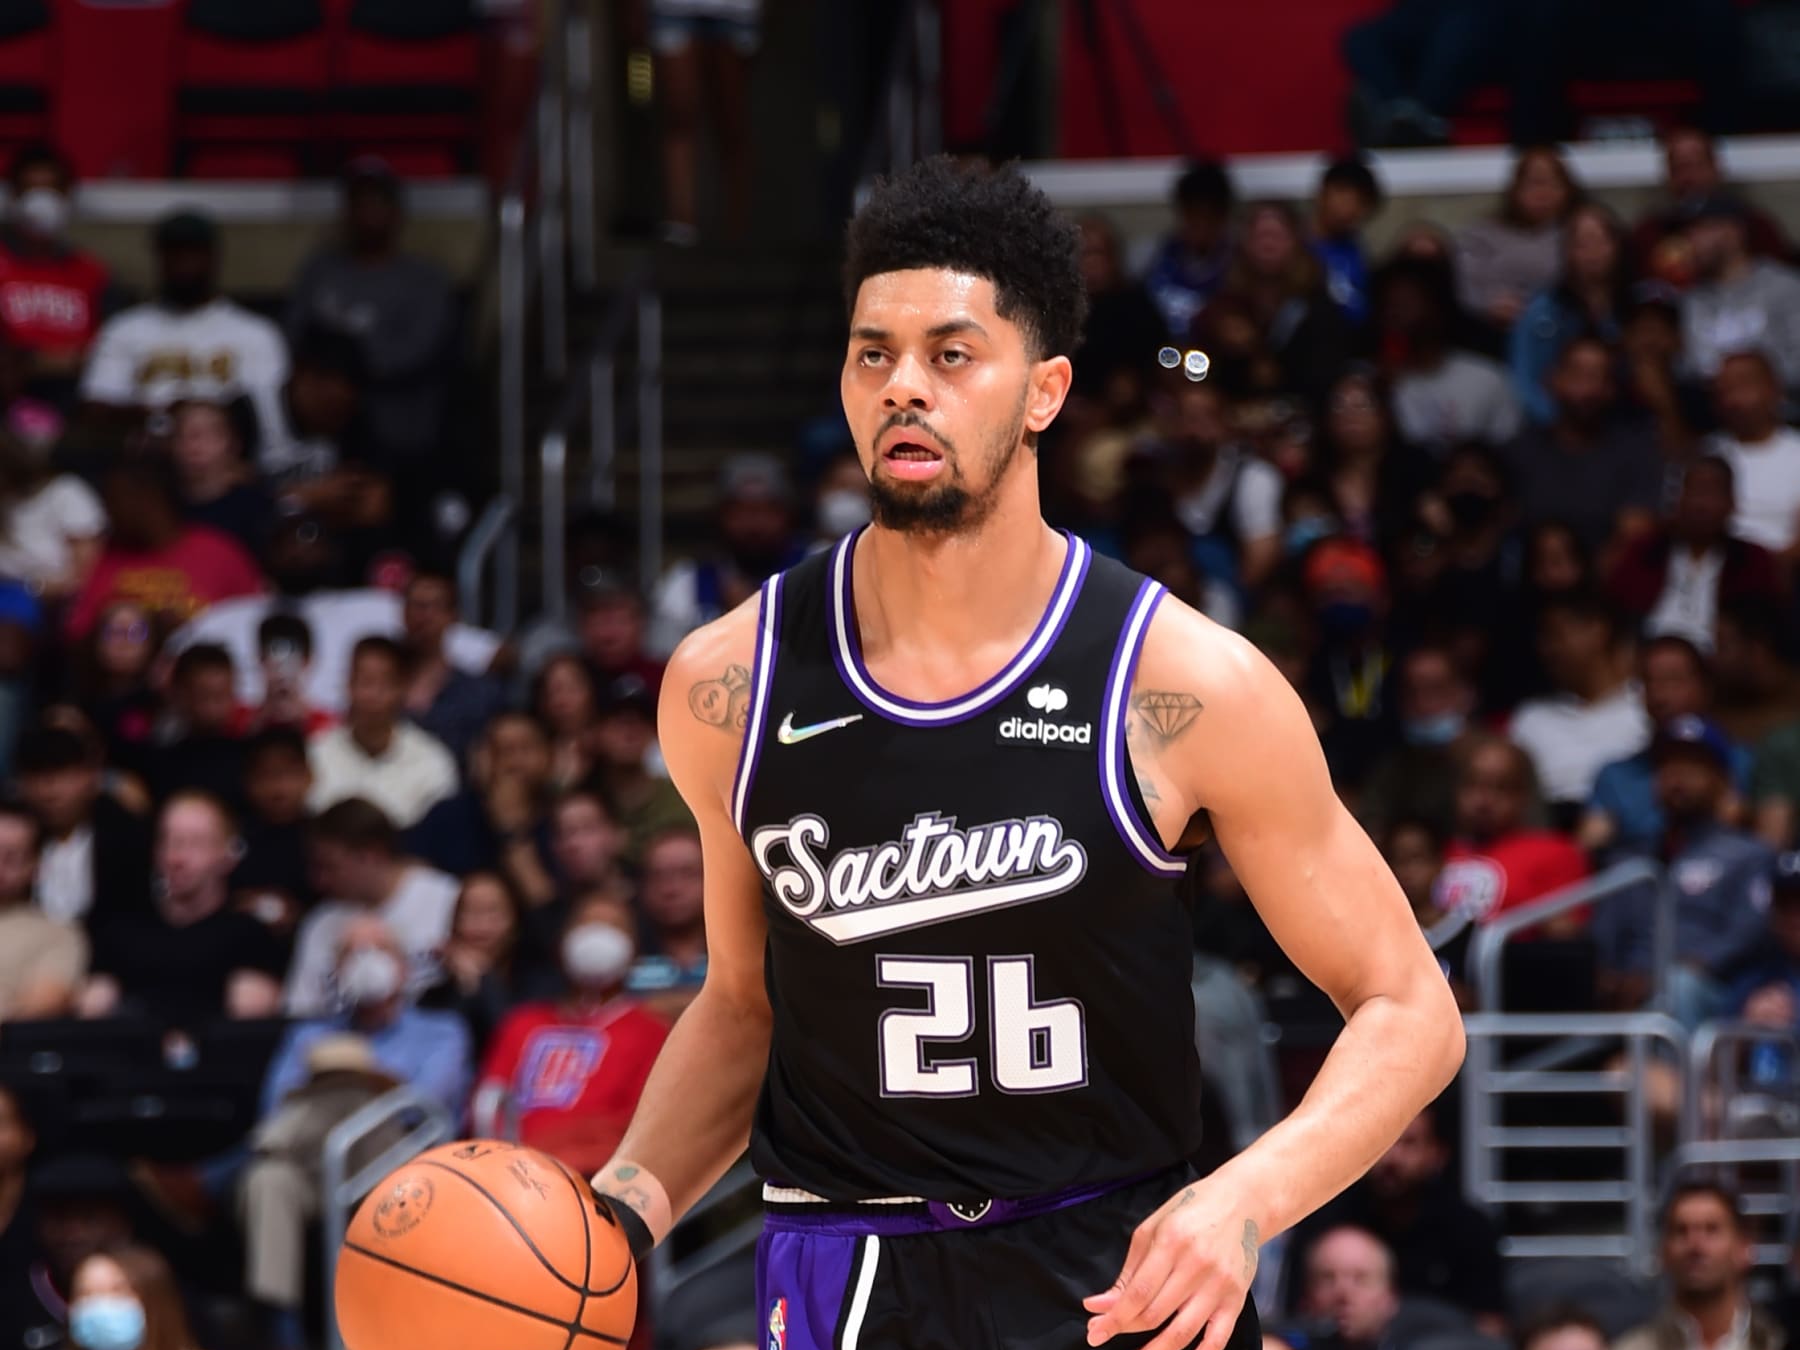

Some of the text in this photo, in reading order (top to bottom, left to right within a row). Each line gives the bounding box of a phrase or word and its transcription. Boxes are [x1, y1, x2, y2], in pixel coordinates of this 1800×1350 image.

[999, 717, 1092, 745] dialpad
[752, 811, 1088, 924] Sactown
[875, 953, 1089, 1099] 26
